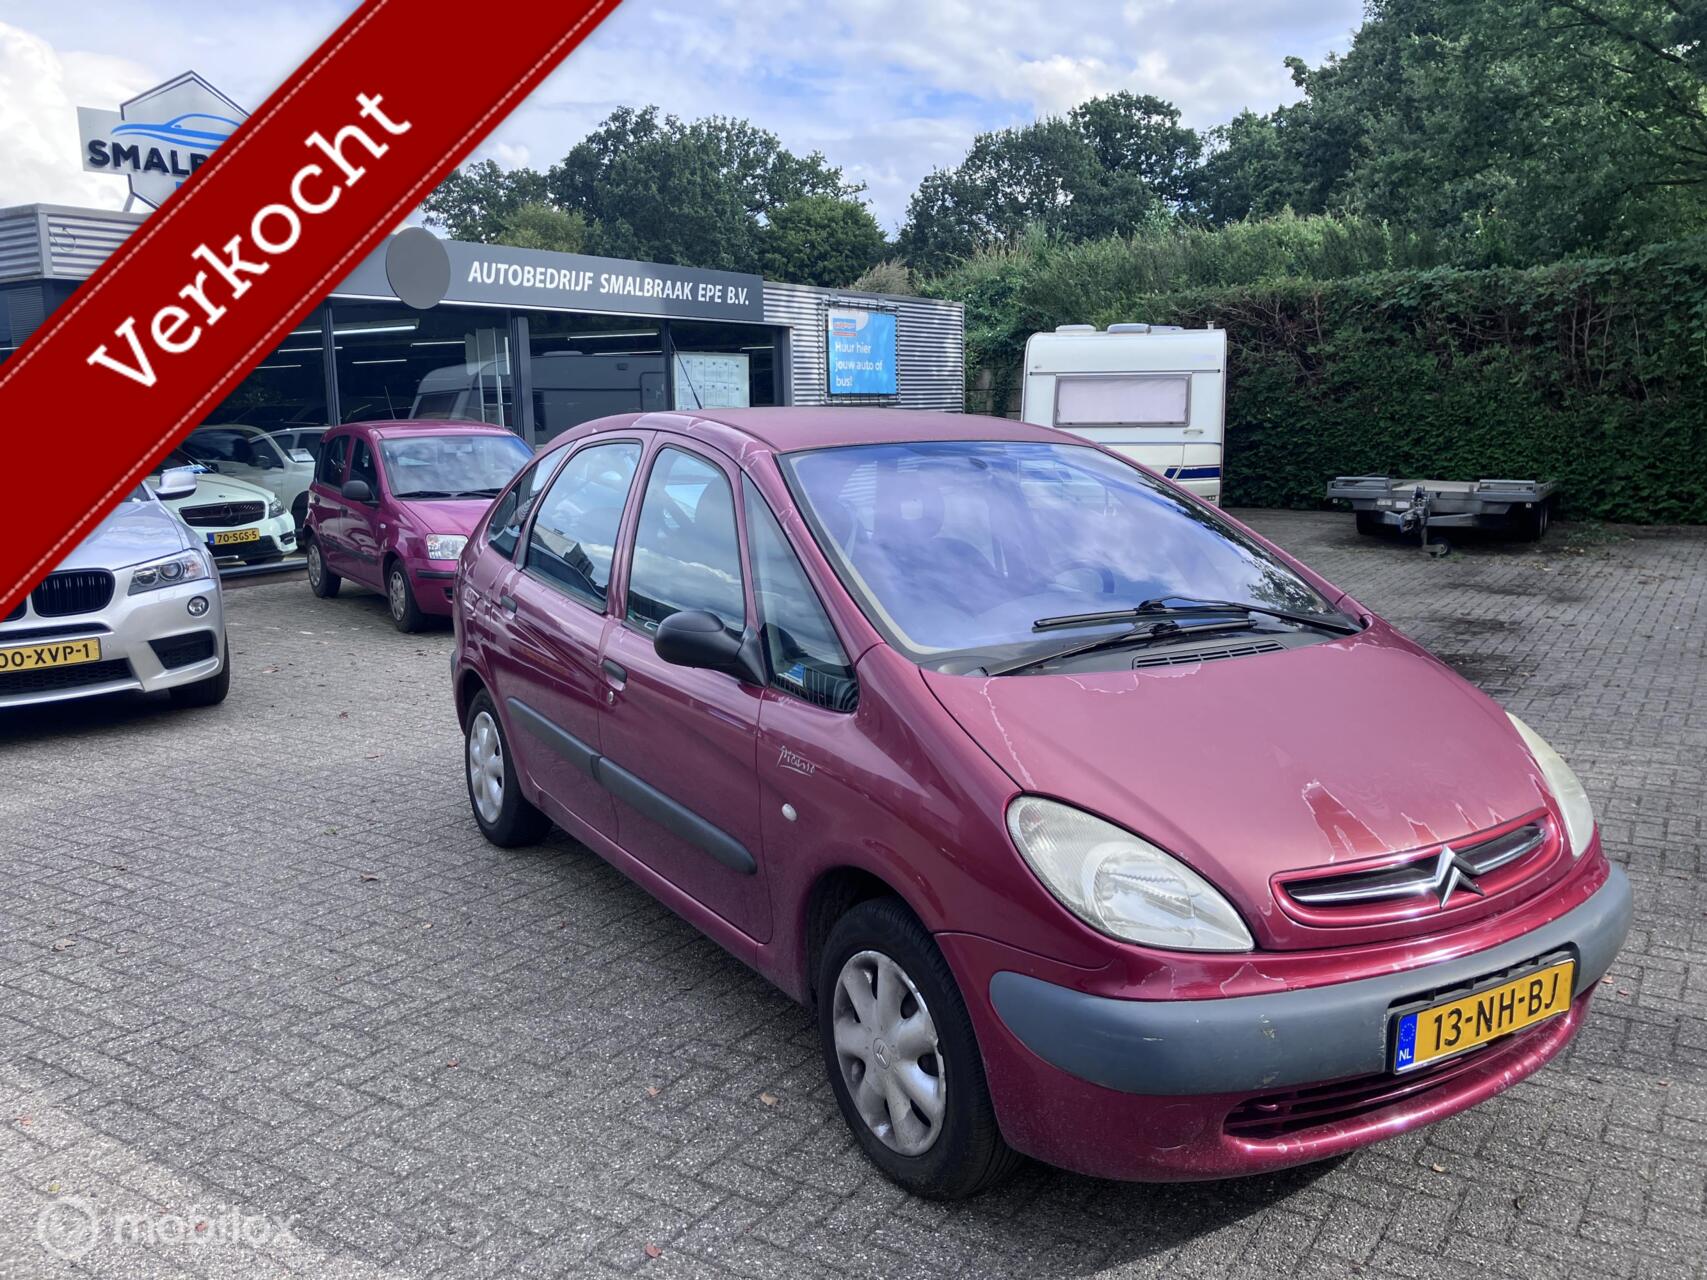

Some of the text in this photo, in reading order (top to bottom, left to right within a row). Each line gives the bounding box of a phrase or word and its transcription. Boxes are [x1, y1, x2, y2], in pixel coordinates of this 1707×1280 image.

[468, 260, 749, 305] AUTOBEDRIJF SMALBRAAK EPE B.V.
[834, 341, 872, 354] Huur hier
[834, 360, 883, 372] jouw auto of
[216, 530, 258, 544] 70-SGS-5
[1434, 972, 1560, 1051] 13-NH-BJ
[1399, 1050, 1413, 1062] NL
